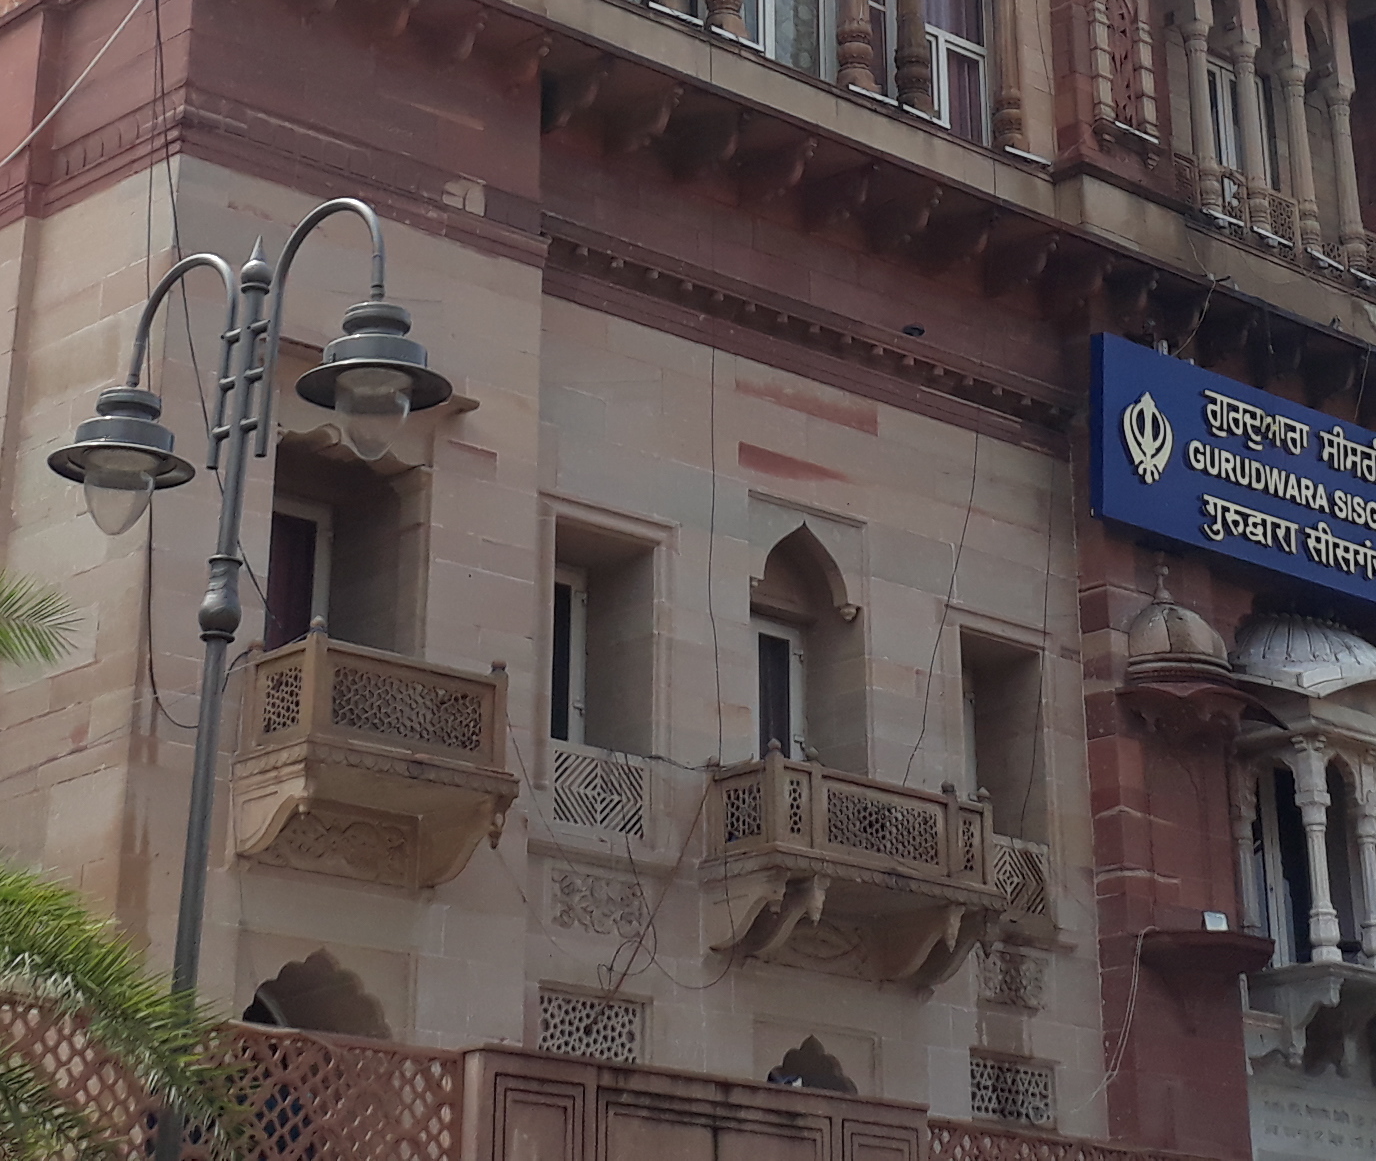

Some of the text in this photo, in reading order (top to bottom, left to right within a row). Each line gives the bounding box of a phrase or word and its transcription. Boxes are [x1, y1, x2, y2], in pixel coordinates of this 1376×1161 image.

[1204, 389, 1309, 455] ਗੁਰਦੁਆਰਾ
[1188, 440, 1330, 513] GURUDWARA
[1203, 493, 1299, 554] गुरुद्वारा
